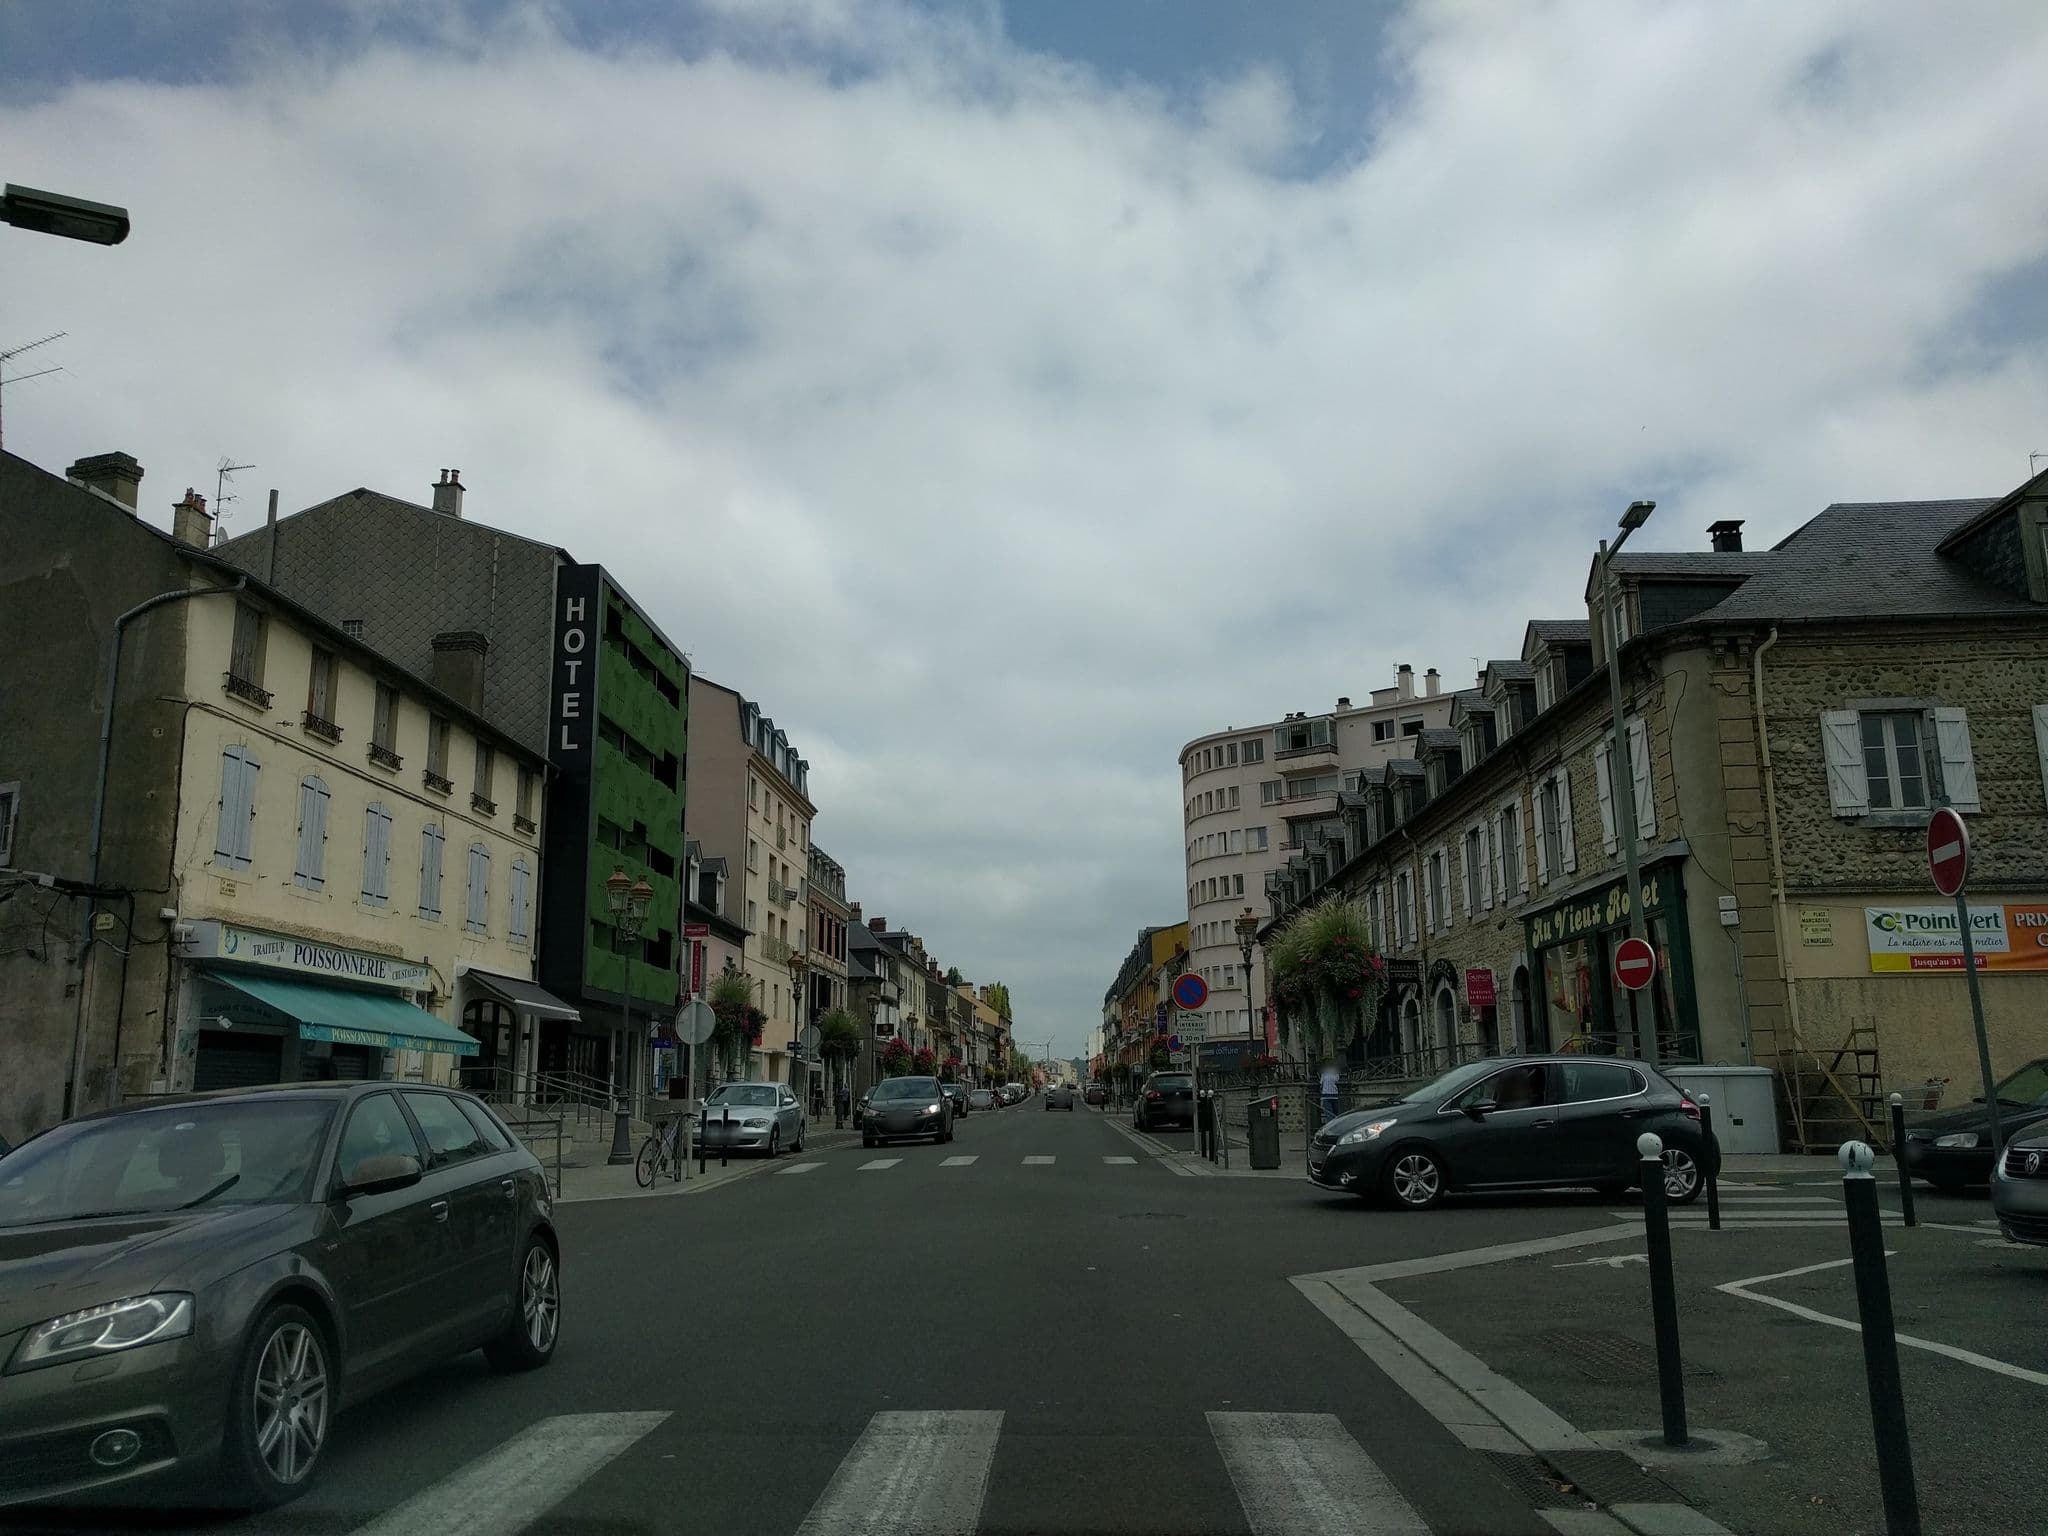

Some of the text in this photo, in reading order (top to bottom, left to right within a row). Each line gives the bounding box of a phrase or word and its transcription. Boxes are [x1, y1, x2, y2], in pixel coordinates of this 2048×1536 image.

[561, 597, 587, 750] HOTEL
[1532, 876, 1660, 949] Au Vieux Roet
[1905, 912, 1957, 930] Point
[1888, 936, 1899, 947] La
[1902, 936, 1932, 947] nature
[1934, 937, 1948, 946] est
[1975, 937, 2004, 946] métier
[252, 941, 286, 957] TRAITEUR
[293, 943, 387, 979] POISSONNERIE
[1913, 957, 1950, 968] Jusqu'au
[1951, 957, 1961, 966] 31
[331, 1028, 389, 1046] POISSONNERIE
